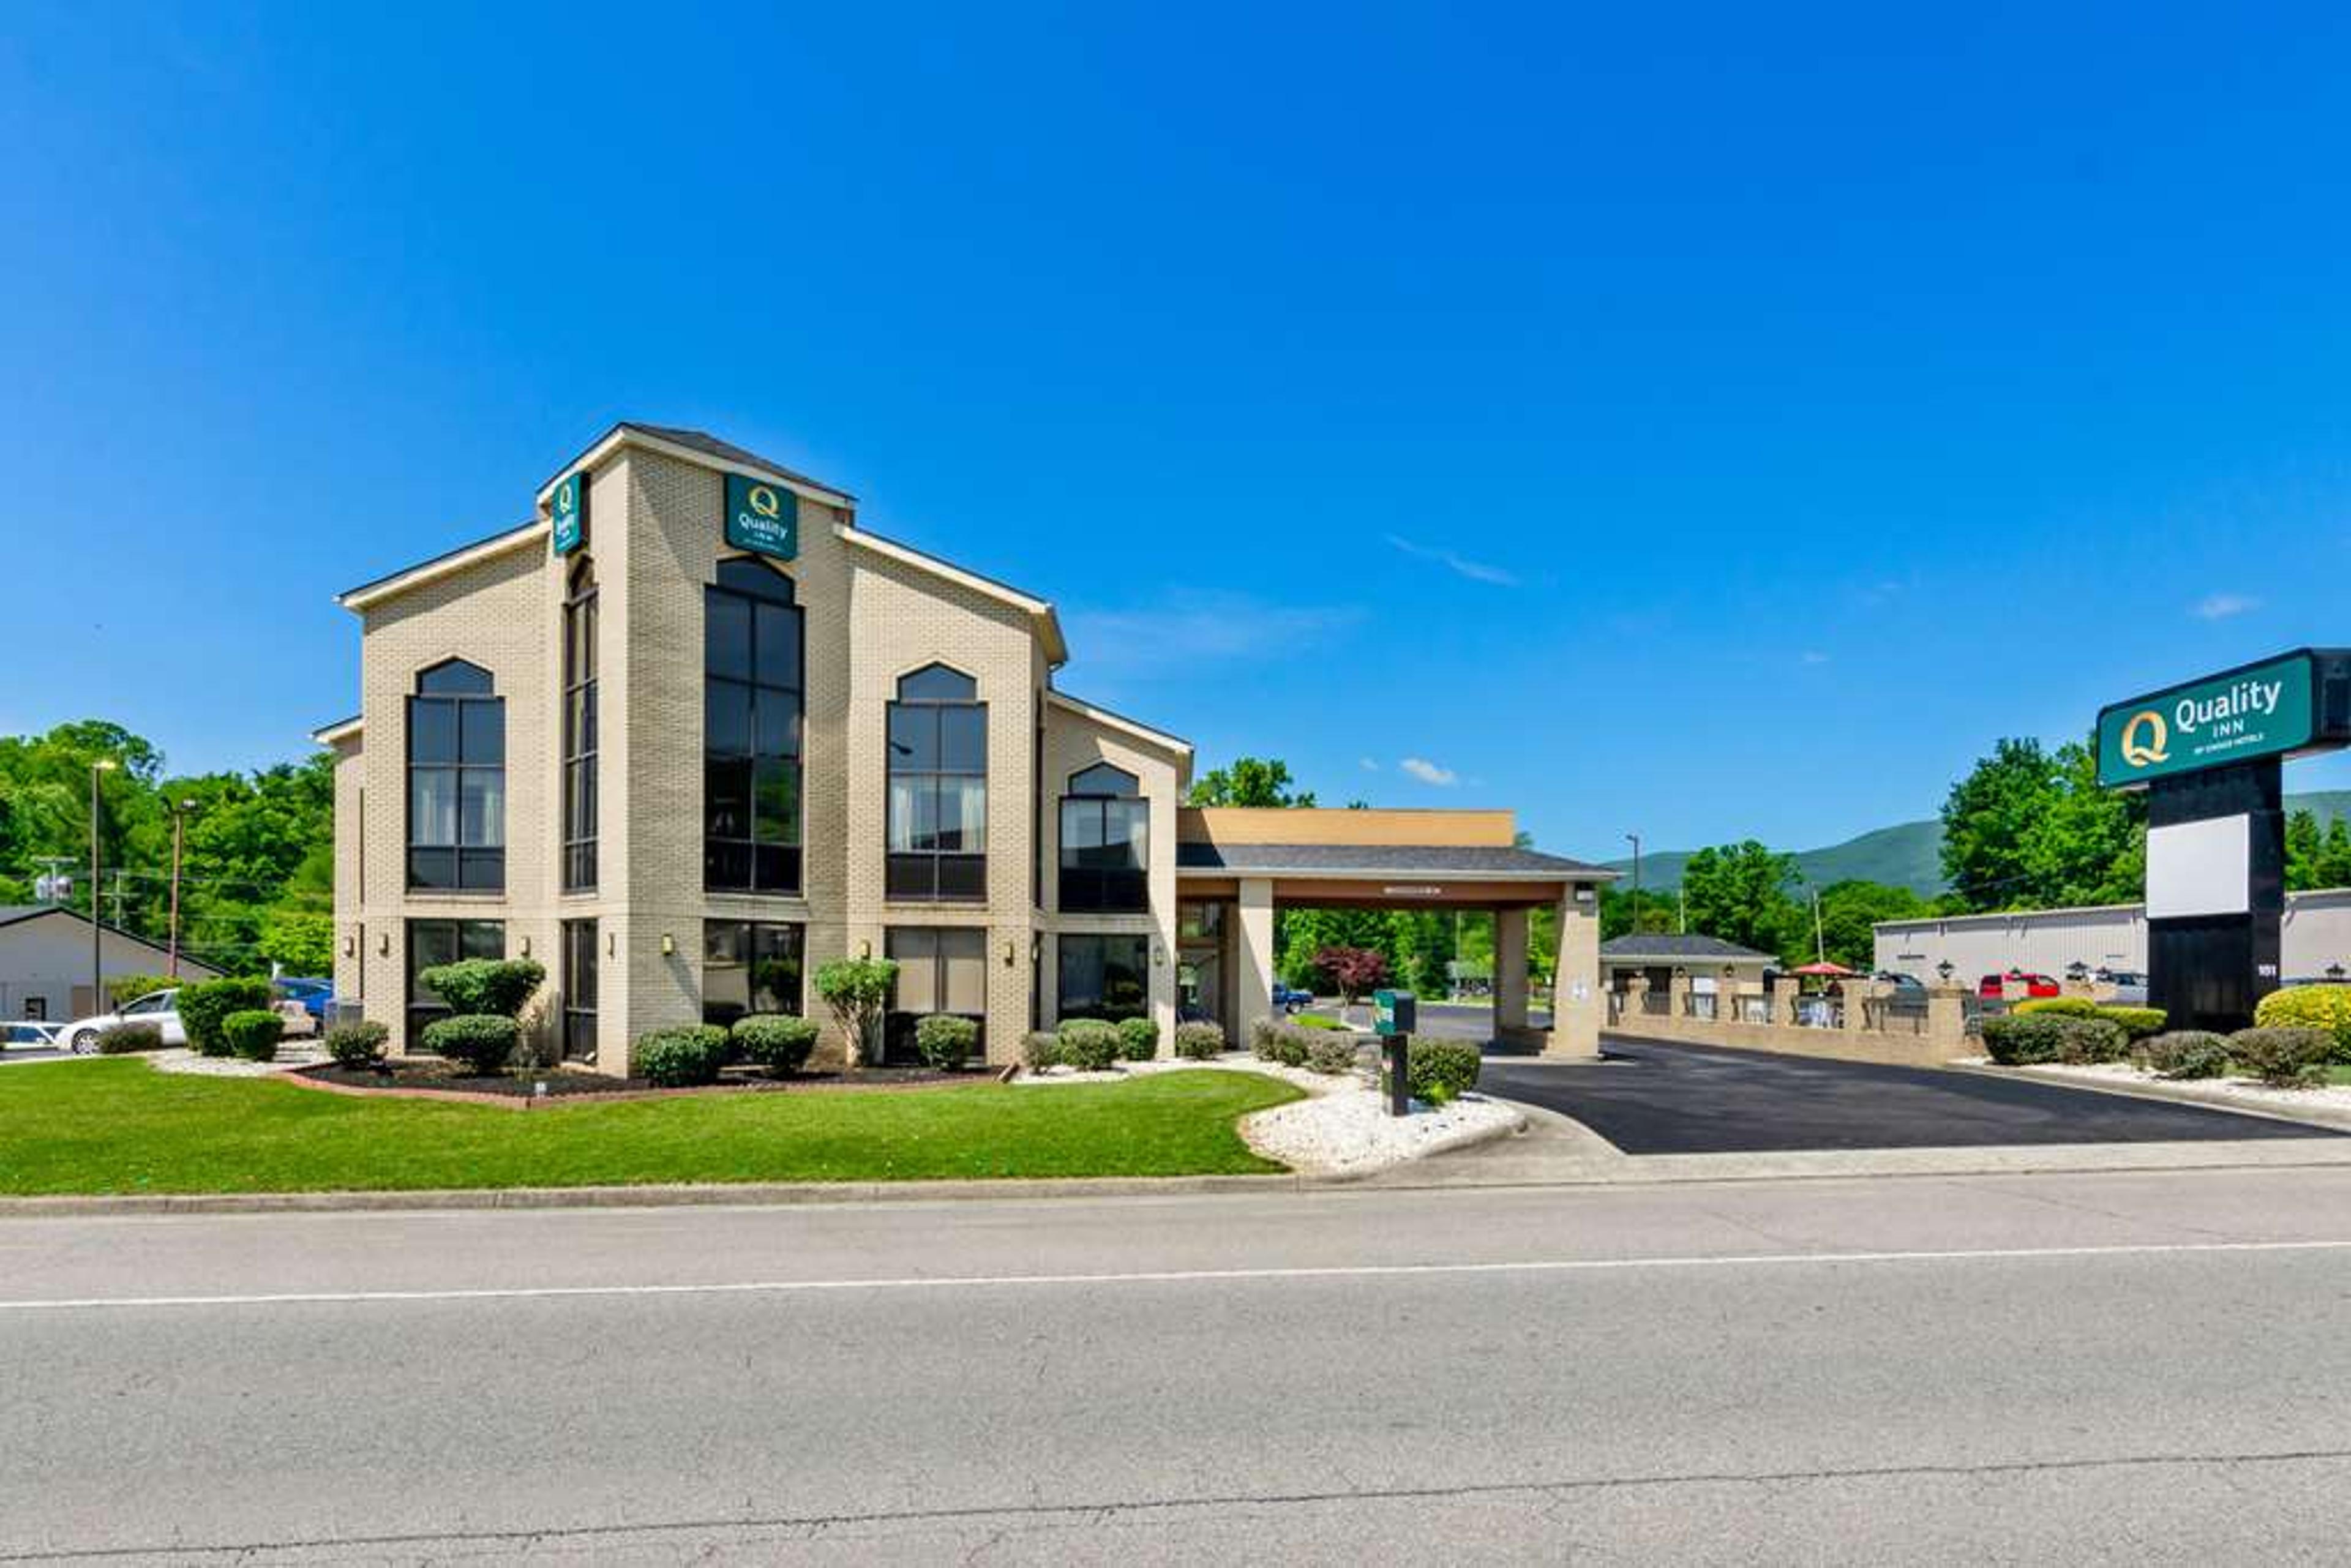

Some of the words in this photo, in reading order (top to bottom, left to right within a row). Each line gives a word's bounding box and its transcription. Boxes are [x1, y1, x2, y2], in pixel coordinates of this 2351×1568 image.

[560, 484, 572, 513] Q
[750, 486, 779, 519] Q
[2175, 681, 2282, 733] Quality
[2121, 710, 2170, 767] Q
[2213, 718, 2244, 738] INN
